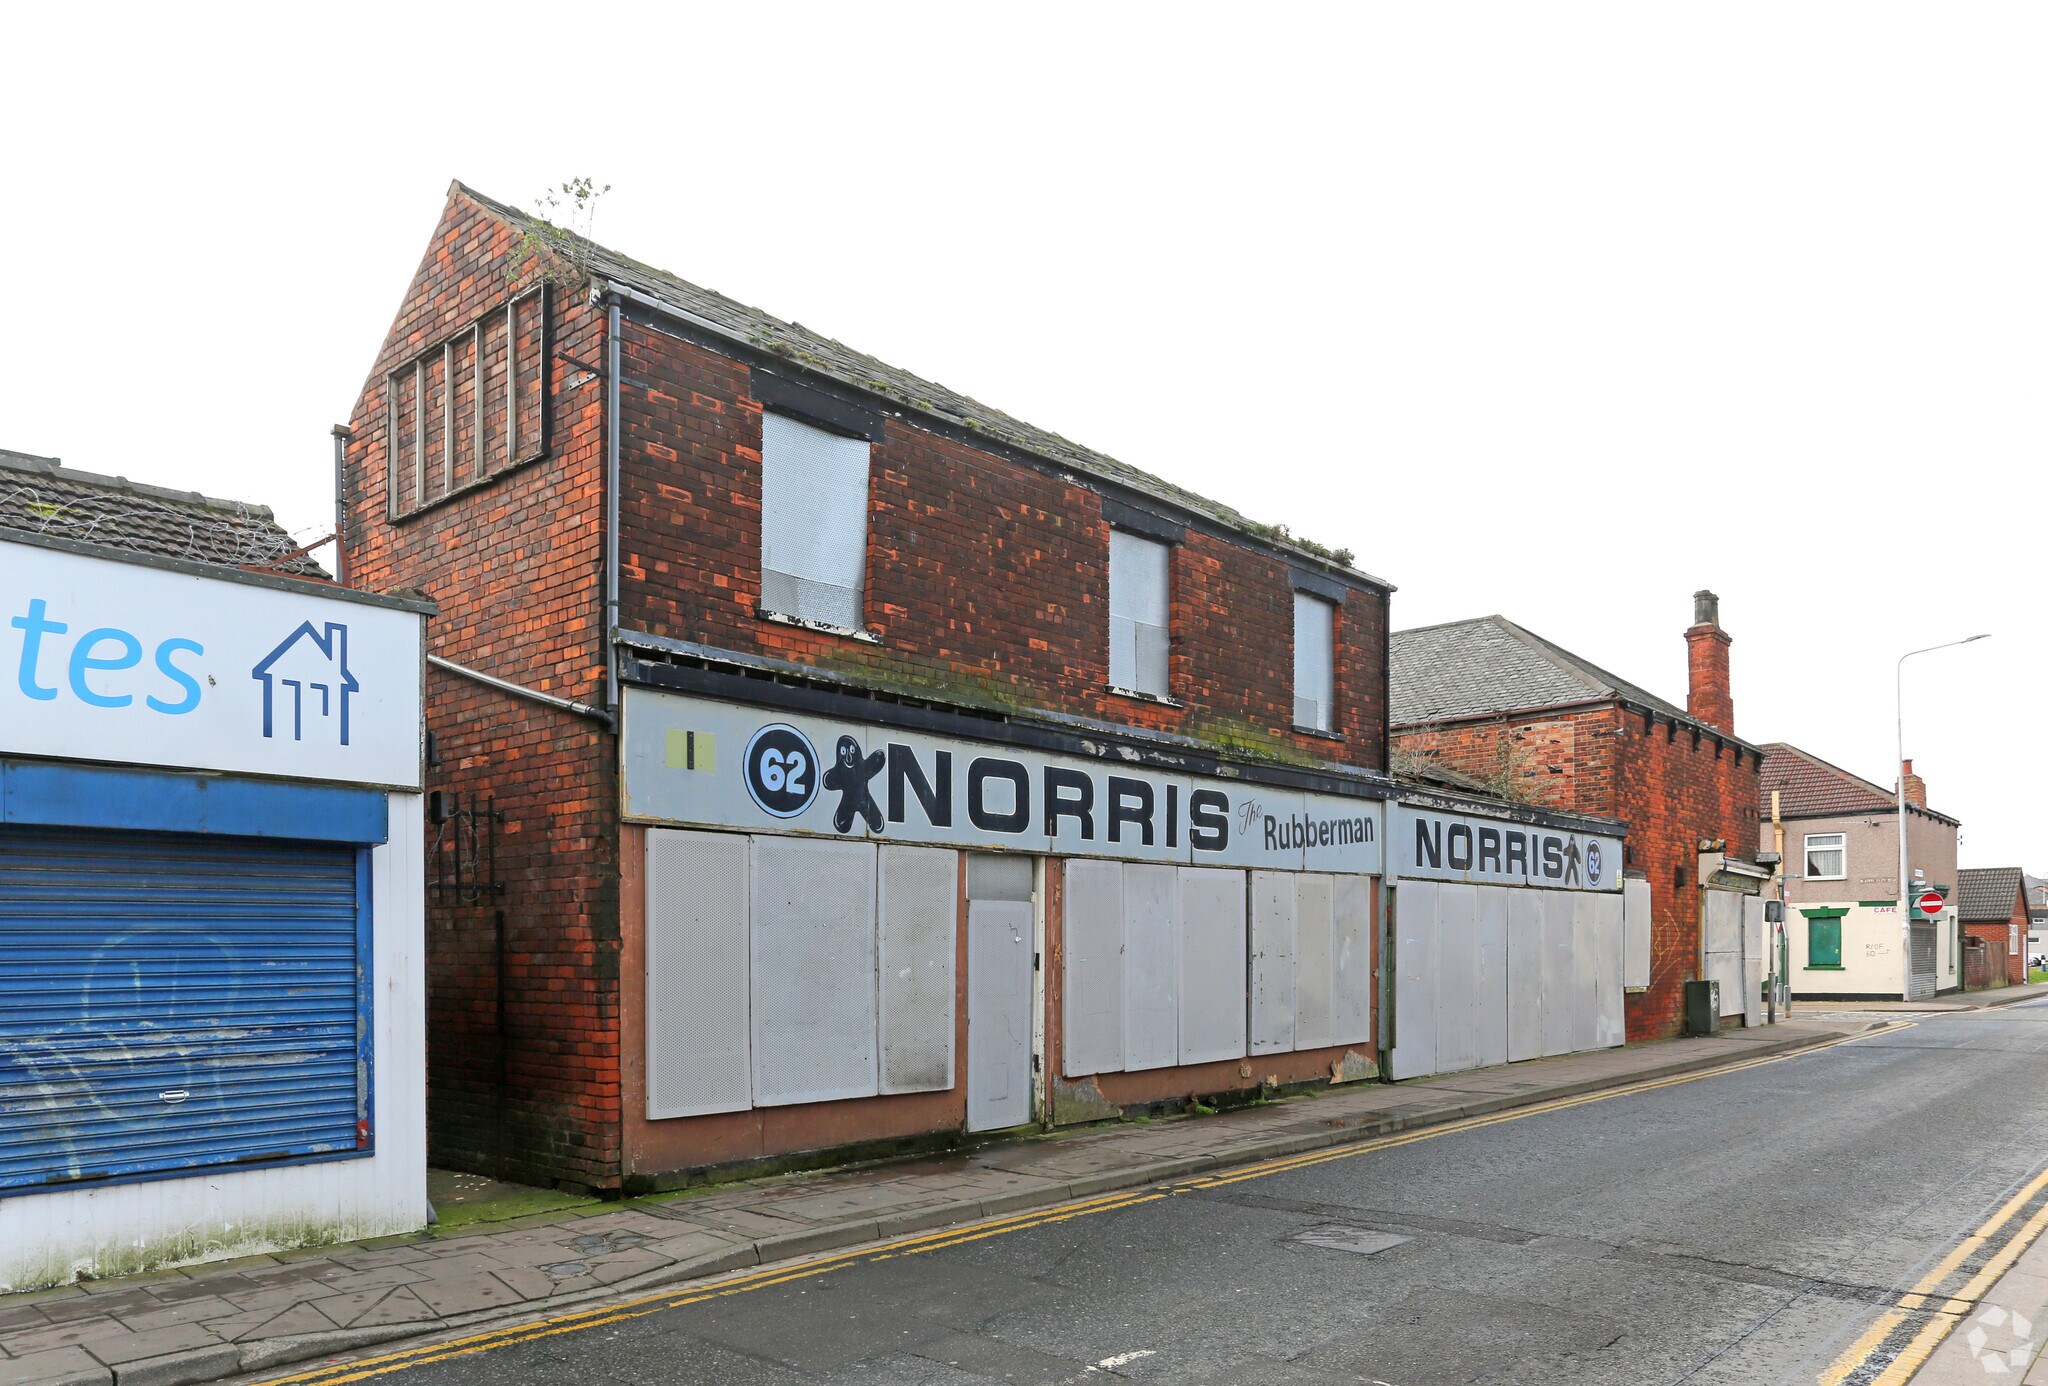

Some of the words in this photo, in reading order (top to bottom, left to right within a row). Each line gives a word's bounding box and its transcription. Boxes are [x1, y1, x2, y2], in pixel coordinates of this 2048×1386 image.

[11, 598, 204, 715] tes
[759, 747, 806, 795] 62
[887, 741, 1229, 852] NORRIS
[1238, 798, 1263, 835] The
[1264, 813, 1374, 850] Rubberman
[1415, 818, 1563, 879] NORRIS
[1588, 851, 1600, 875] 62
